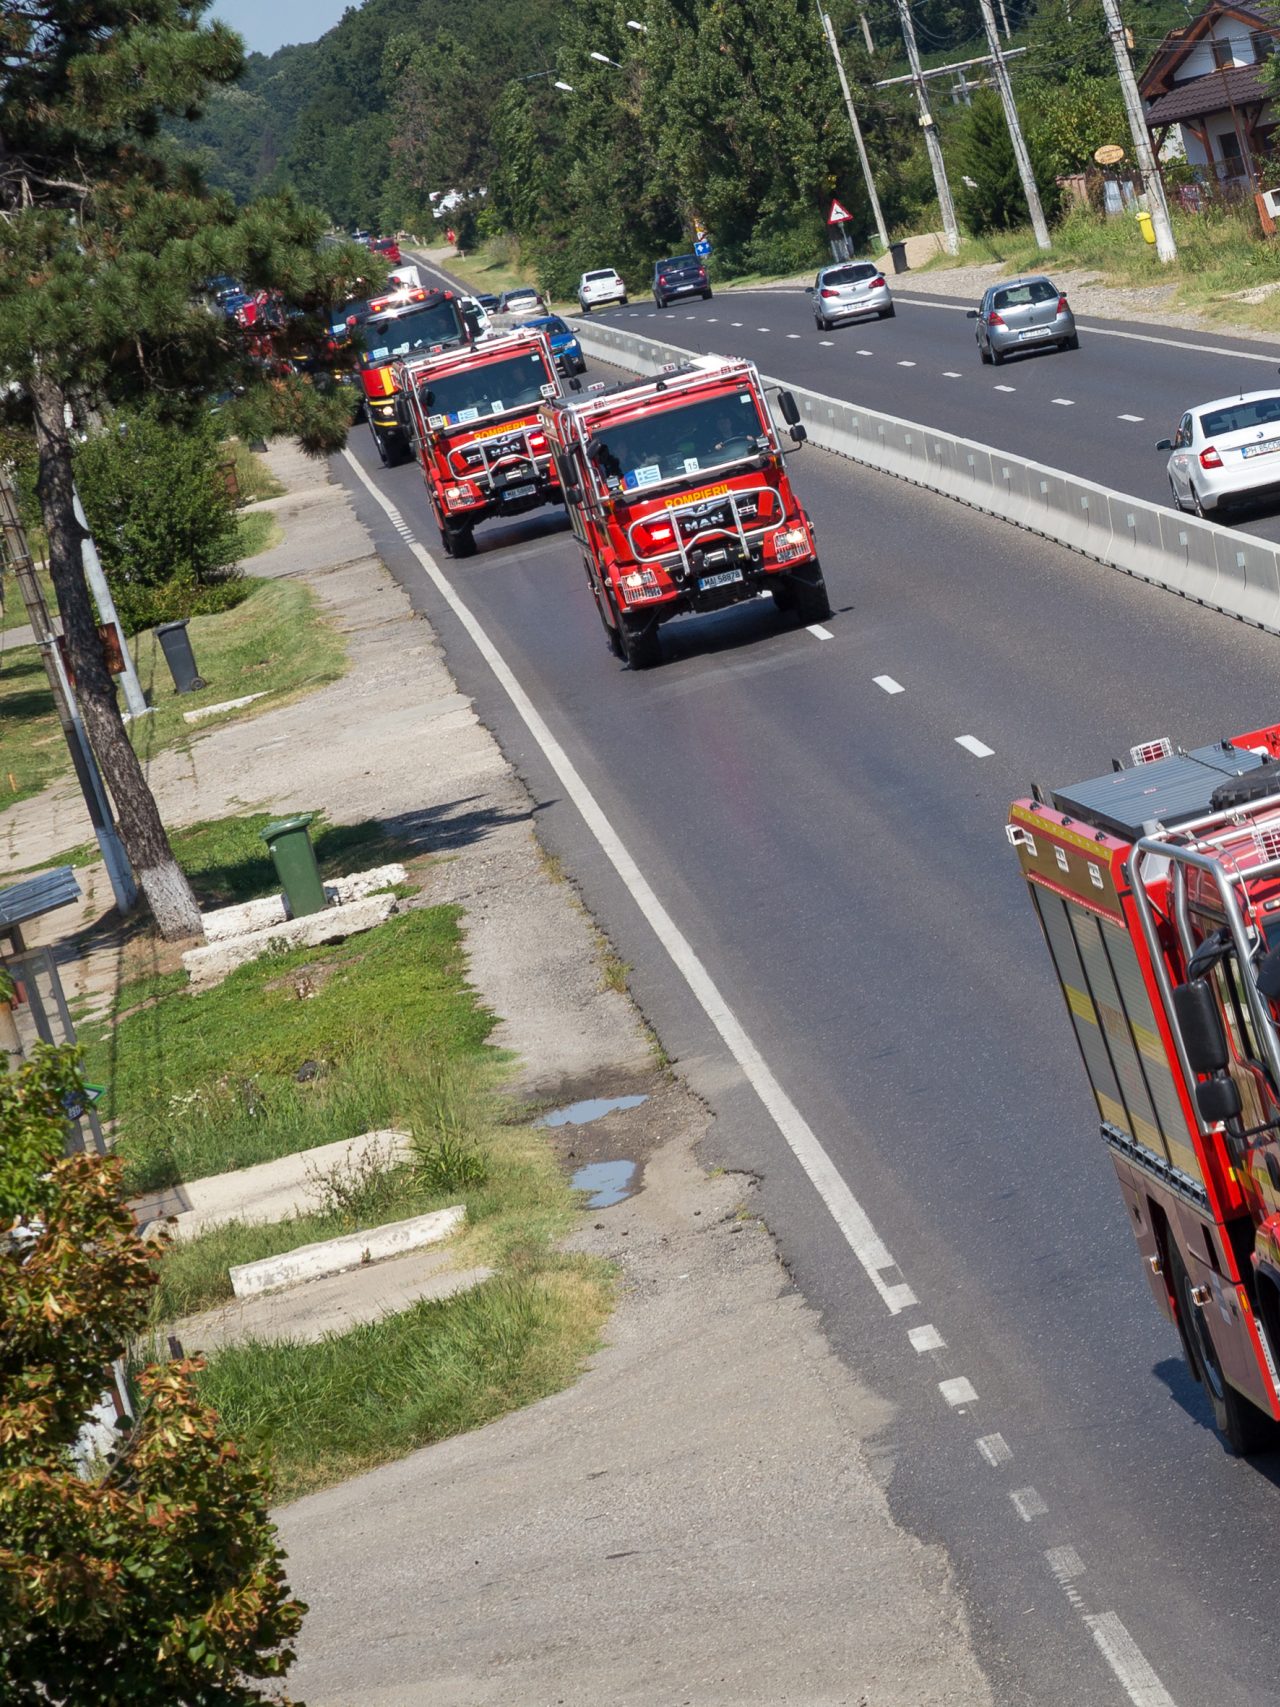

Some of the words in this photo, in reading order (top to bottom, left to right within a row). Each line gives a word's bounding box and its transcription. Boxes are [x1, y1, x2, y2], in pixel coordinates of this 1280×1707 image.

[490, 441, 520, 456] MAN
[688, 463, 698, 471] 15
[664, 484, 728, 507] POMPIERII
[685, 512, 724, 531] MAN
[704, 576, 717, 587] MAI
